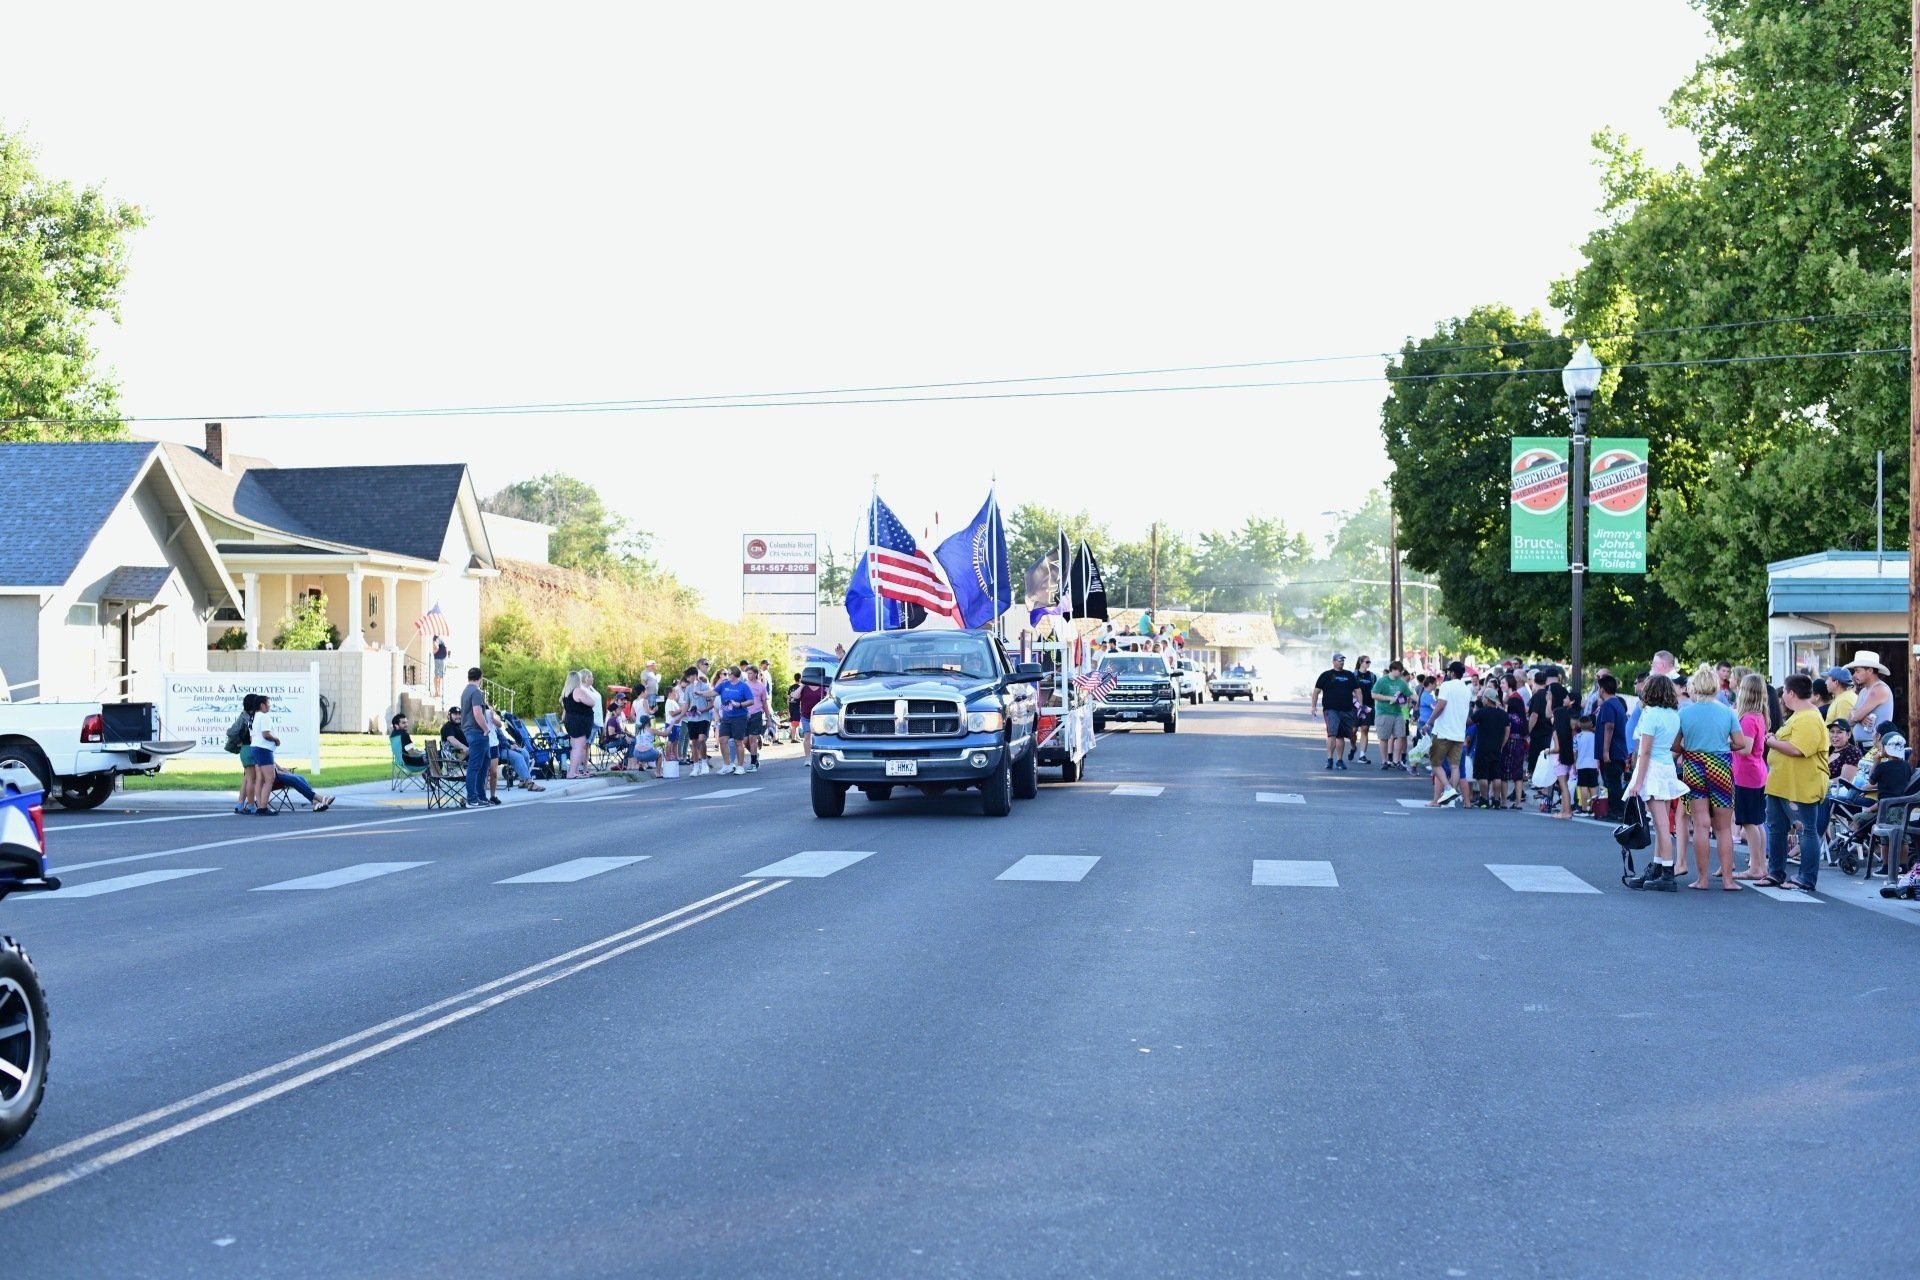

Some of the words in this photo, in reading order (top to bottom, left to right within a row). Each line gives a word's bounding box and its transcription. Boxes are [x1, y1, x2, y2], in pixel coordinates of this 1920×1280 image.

[1513, 464, 1562, 489] DOWNTOWN
[1592, 466, 1641, 490] DOWNTOWN
[1516, 475, 1567, 498] HERMISTON
[1595, 477, 1646, 500] HERMISTON
[1593, 529, 1642, 541] Jimmy's
[797, 541, 813, 549] River
[1514, 535, 1554, 549] Bruce
[1600, 540, 1635, 549] Johns
[1592, 549, 1642, 559] Portable
[1600, 559, 1636, 569] Toilets
[172, 683, 214, 694] CONNELL
[217, 684, 226, 693] &
[229, 684, 285, 694] ASSOCIATES
[288, 686, 305, 694] LLC
